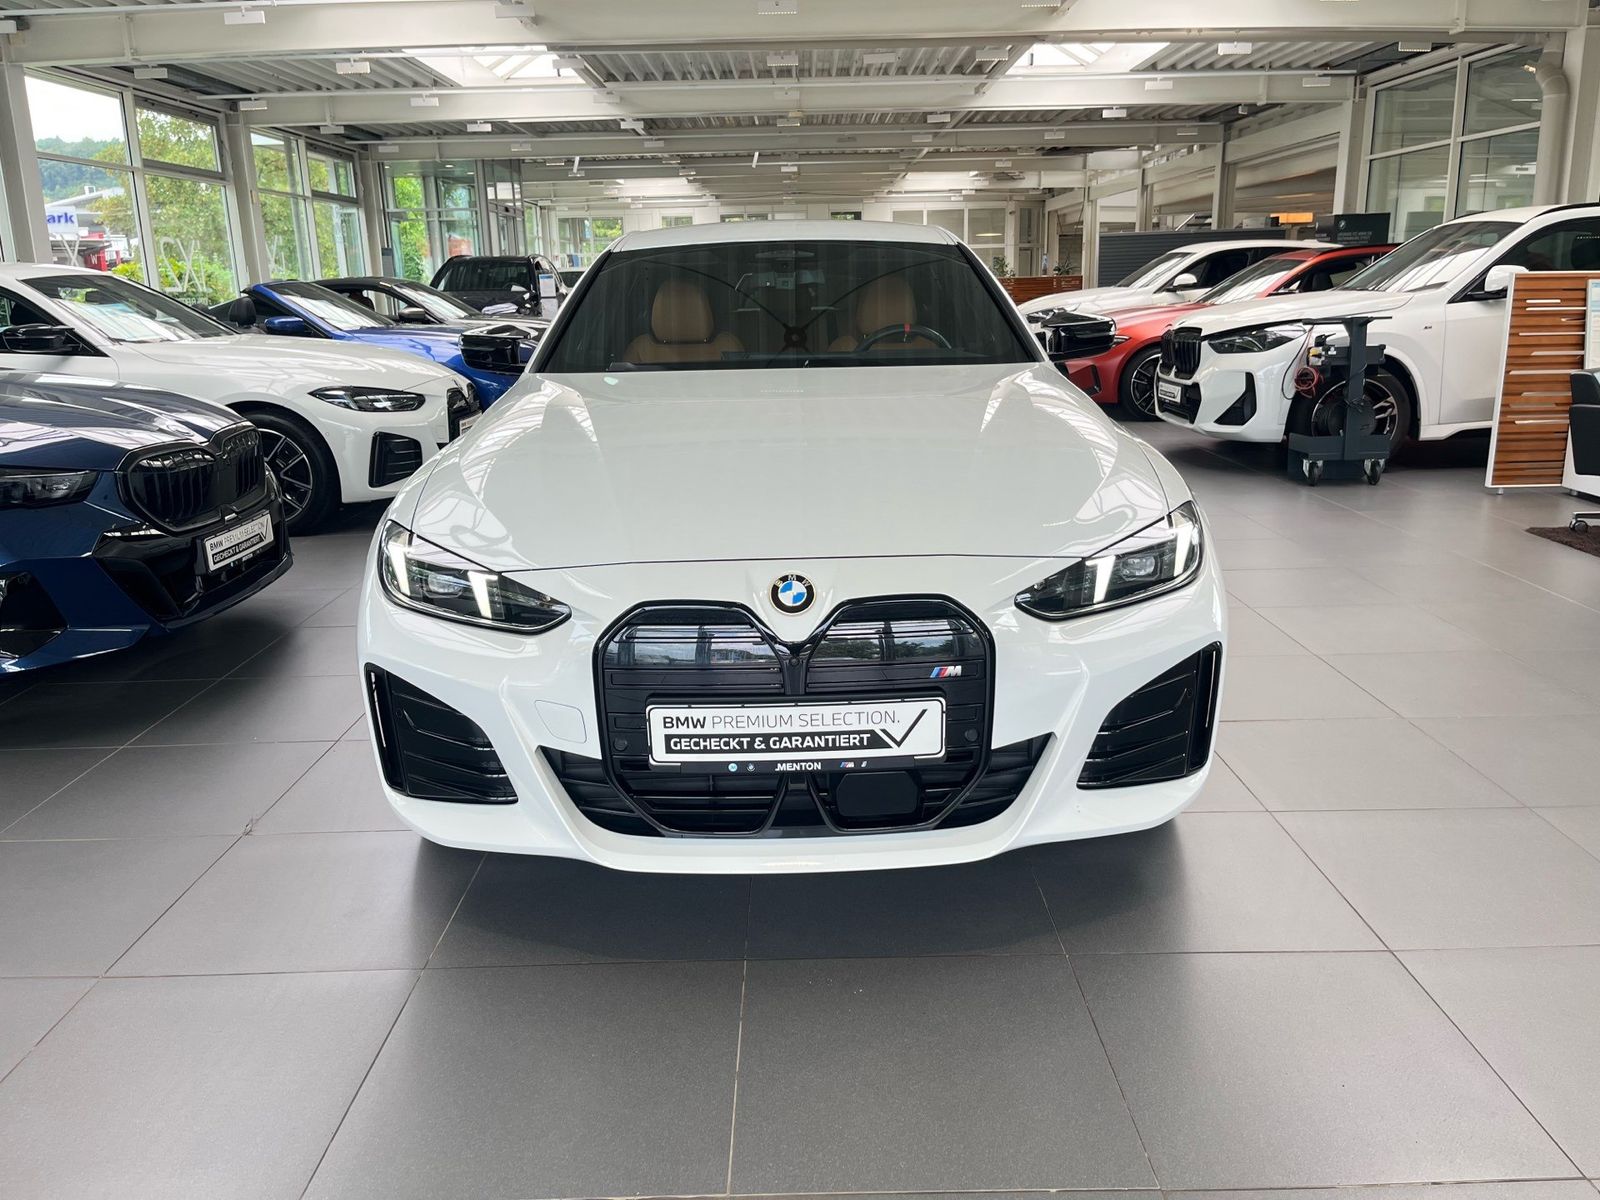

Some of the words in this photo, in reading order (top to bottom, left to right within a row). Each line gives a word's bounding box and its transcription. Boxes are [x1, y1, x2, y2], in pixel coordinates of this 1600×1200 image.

[662, 716, 707, 729] BMW
[711, 714, 793, 729] PREMIUM
[798, 710, 901, 728] SELECTION.
[670, 737, 751, 751] GECHECKT
[754, 736, 767, 749] &
[769, 733, 871, 749] GARANTIERT
[775, 762, 822, 772] MENTON
